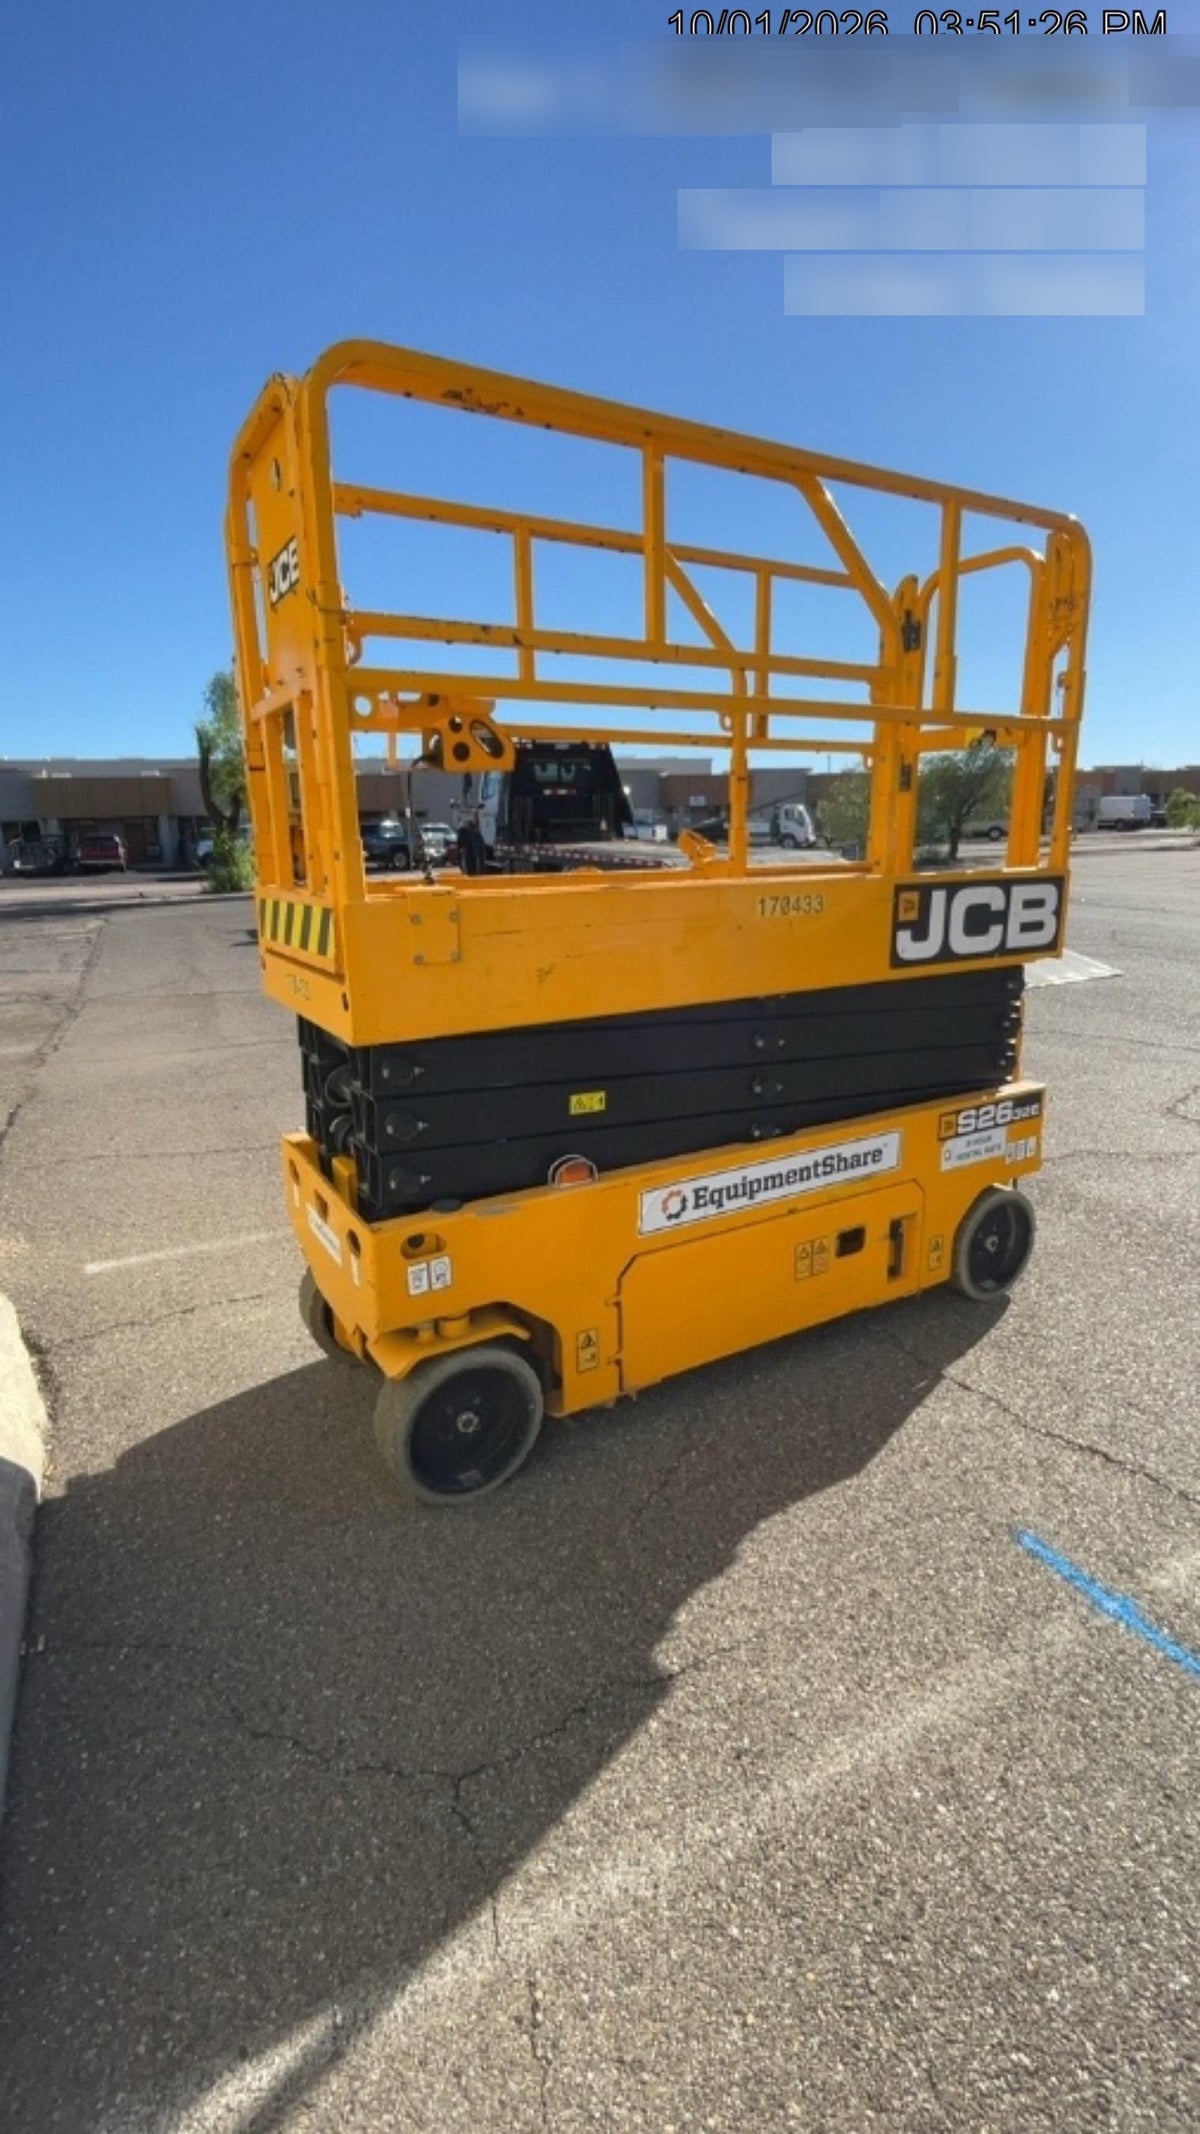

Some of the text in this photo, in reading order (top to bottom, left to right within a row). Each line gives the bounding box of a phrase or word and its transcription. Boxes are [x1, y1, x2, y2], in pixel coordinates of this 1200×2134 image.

[758, 893, 824, 917] 170433
[896, 883, 1059, 961] JCB
[692, 1147, 883, 1211] EquipmentShare
